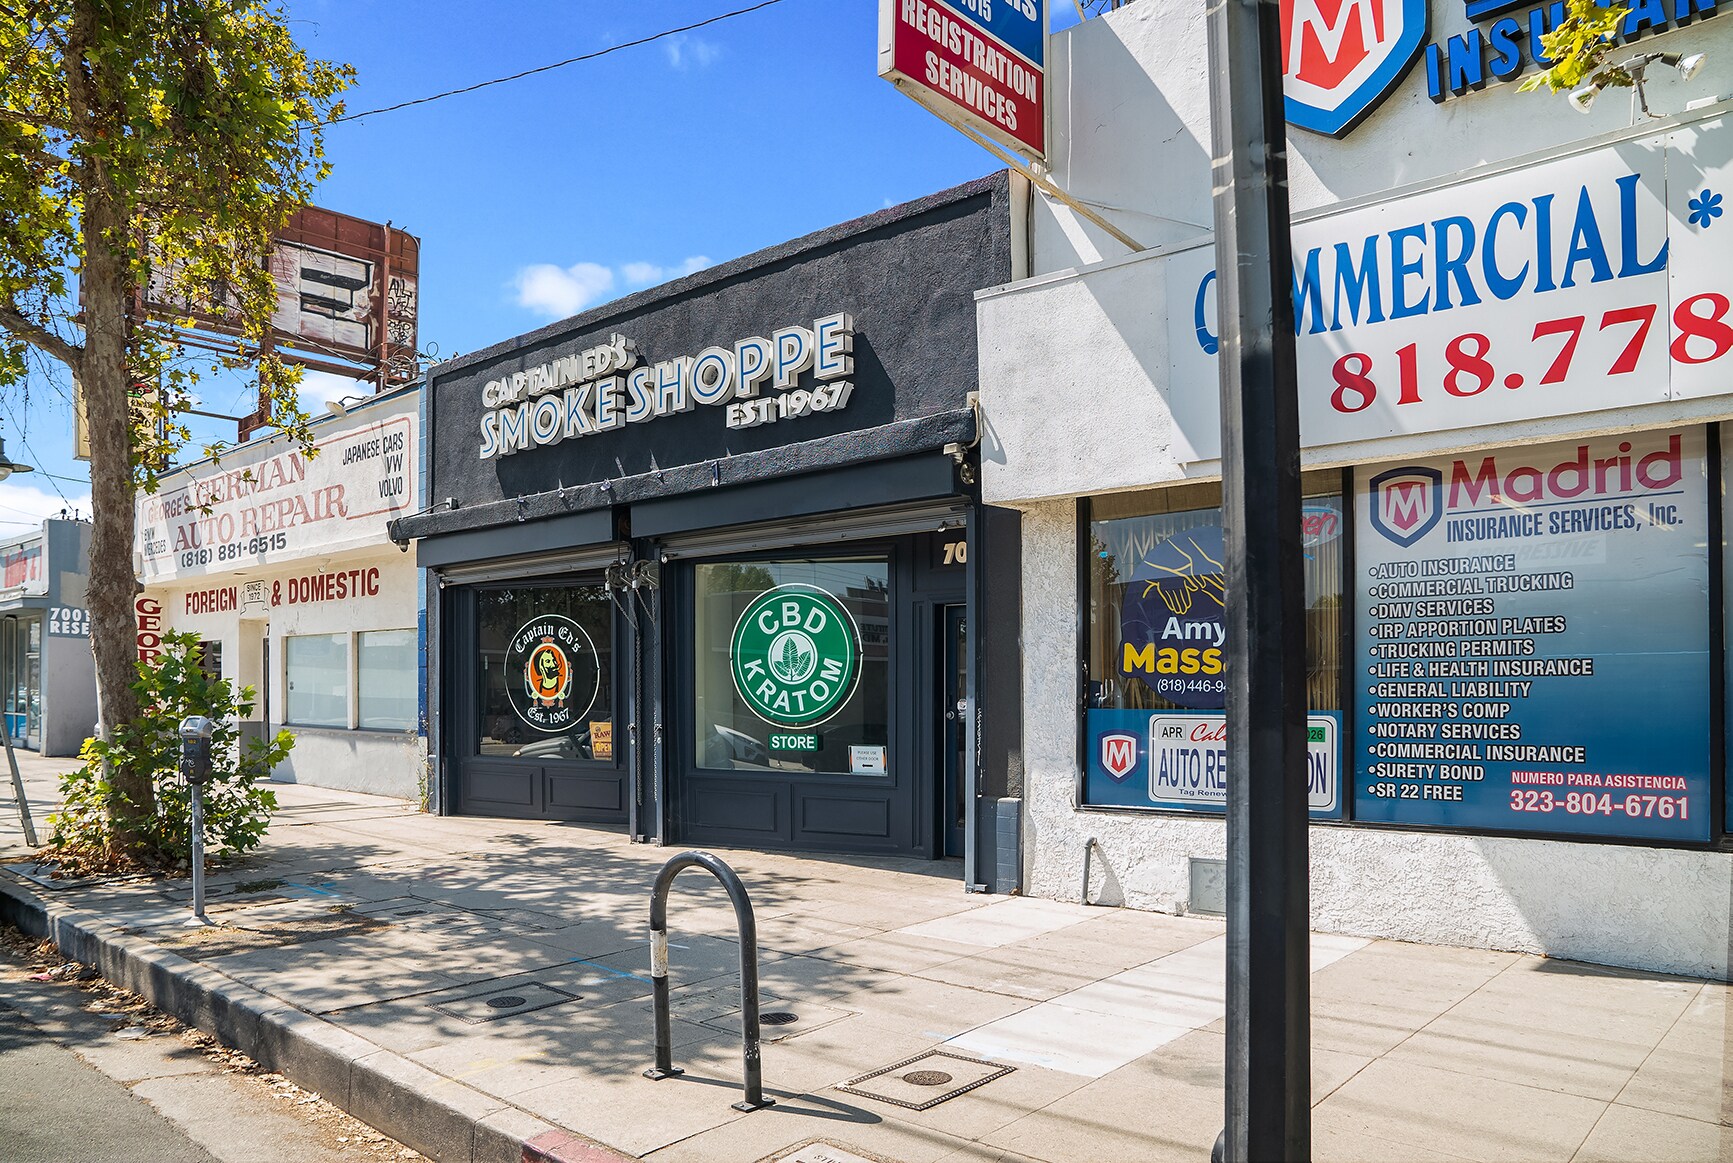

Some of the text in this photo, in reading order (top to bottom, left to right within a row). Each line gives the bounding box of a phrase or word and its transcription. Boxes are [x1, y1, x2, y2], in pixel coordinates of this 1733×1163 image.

[901, 0, 1037, 104] REGISTRATION
[925, 50, 1018, 131] SERVICES
[1194, 173, 1670, 356] CMMERCIAL
[726, 380, 854, 430] EST 1967
[342, 431, 404, 466] JAPANESE CARS
[386, 453, 404, 474] VW
[1447, 434, 1683, 509] Madrid
[195, 450, 306, 508] GERMAN
[378, 475, 403, 499] VOLVO
[173, 483, 349, 553] AUTO REPAIR
[1446, 502, 1684, 543] INSURANCE SERVICES, Inc.
[181, 532, 287, 568] (818) 881-6515
[1377, 554, 1515, 579] AUTO INSURANCE
[185, 567, 381, 616] FOREIGN & DOMESTIC
[246, 582, 262, 593] SINCE
[248, 591, 261, 601] 1972
[1378, 572, 1574, 599] COMMERCIAL TRUCKING
[757, 601, 827, 635] CBD
[1378, 598, 1495, 619] DMV SERVICES
[514, 621, 582, 653] Captain Ed's
[1161, 616, 1226, 647] Amy
[1378, 616, 1567, 639] IRP APPORTION PLATES
[1123, 642, 1226, 675] Mass
[1378, 639, 1535, 659] TRUCKING PERMITS
[1377, 658, 1594, 678] LIFE & HEALTH INSURANCE
[743, 657, 844, 712] KRATOM
[1157, 679, 1186, 694] (818)
[1377, 681, 1533, 698] GENERAL LIABILITY
[548, 707, 570, 724] 1967
[1376, 702, 1511, 719] WORKER'S COMP
[593, 730, 612, 739] RAW
[771, 735, 815, 749] STORE
[1161, 726, 1183, 739] APR
[1377, 722, 1521, 741] NOTARY SERVICES
[1377, 743, 1586, 764] COMMERCIAL INSURANCE
[1158, 747, 1201, 789] AUTO
[1376, 763, 1485, 781] SURETY BOND
[1178, 788, 1195, 797] Tag
[1376, 783, 1463, 801] SR 22 FREE
[1511, 771, 1687, 790] NUMERO PARA ASISTENCIA
[1510, 789, 1688, 821] 323-804-6761
